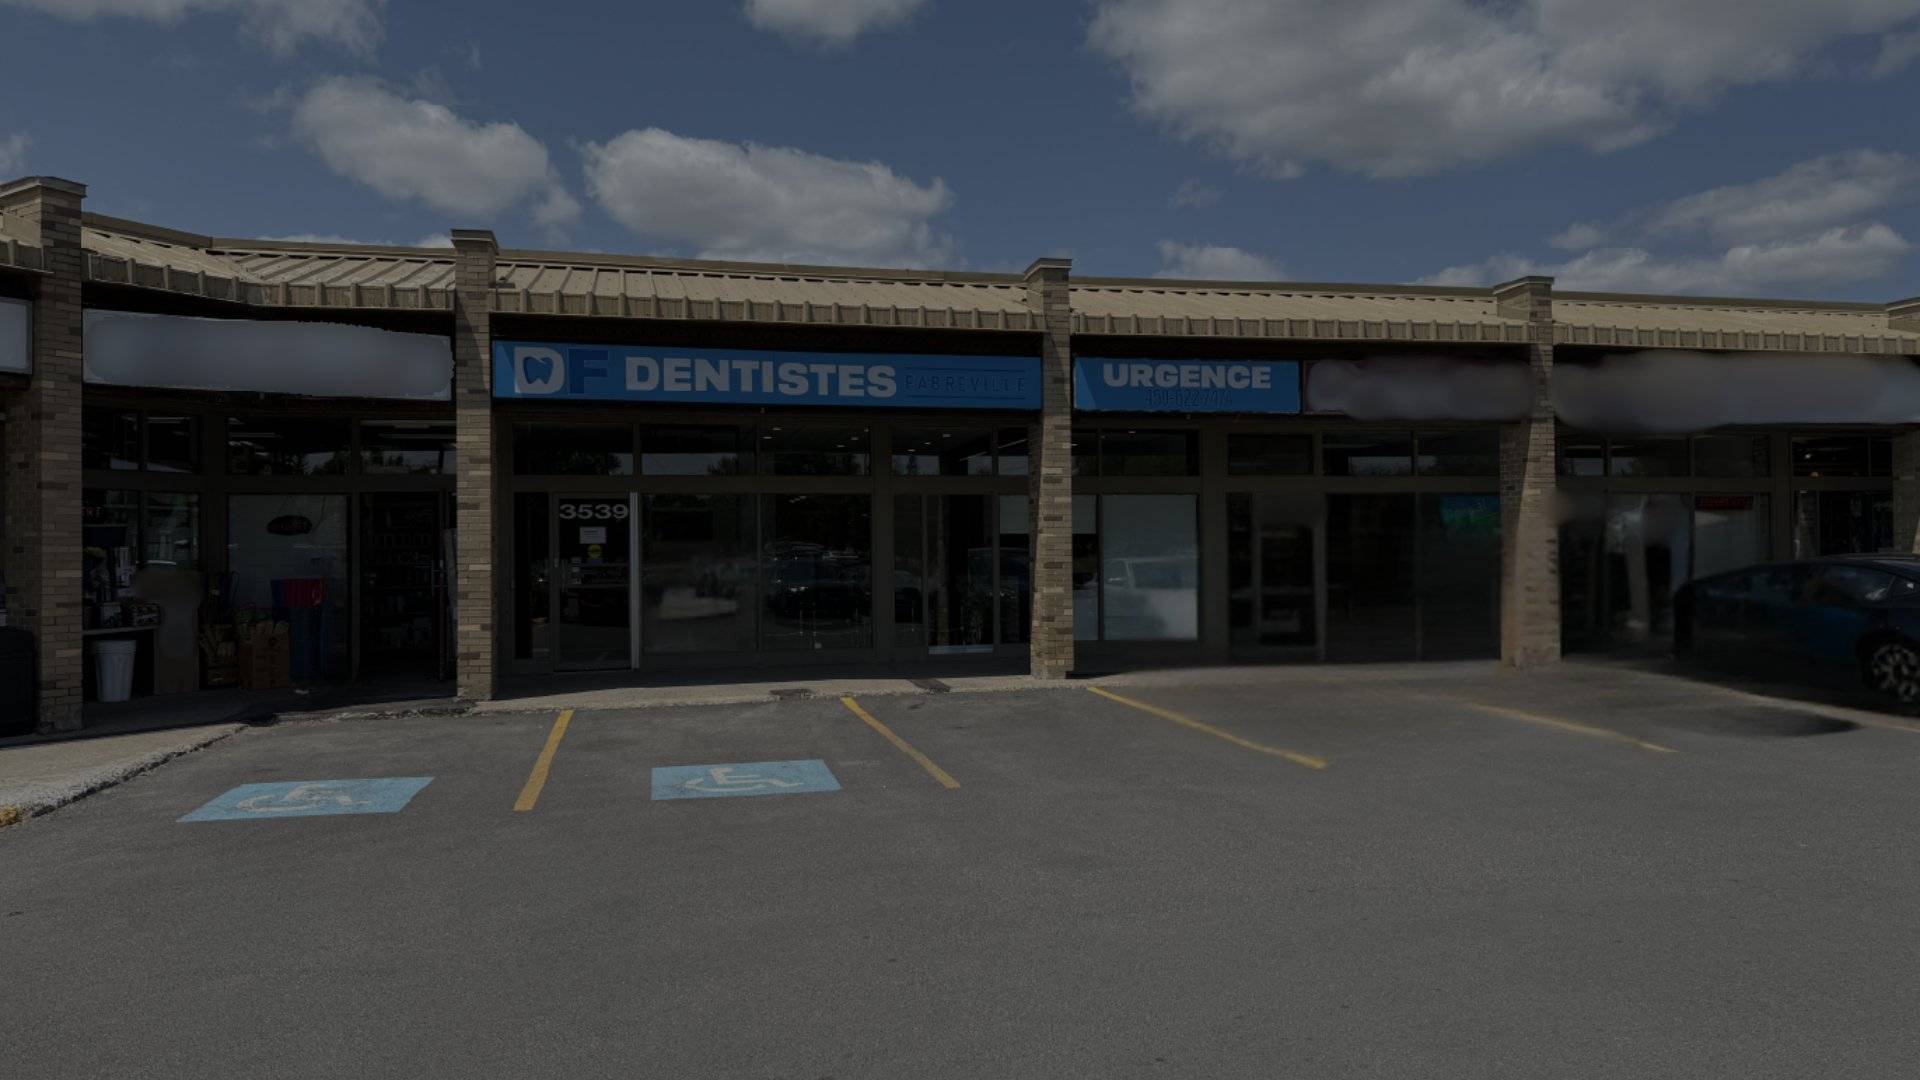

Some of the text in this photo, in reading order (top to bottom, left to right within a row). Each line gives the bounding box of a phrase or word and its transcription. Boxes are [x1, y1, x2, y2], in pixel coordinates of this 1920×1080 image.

[625, 356, 897, 398] DENTISTES
[1104, 363, 1271, 389] URGENCE
[559, 503, 628, 519] 3539
